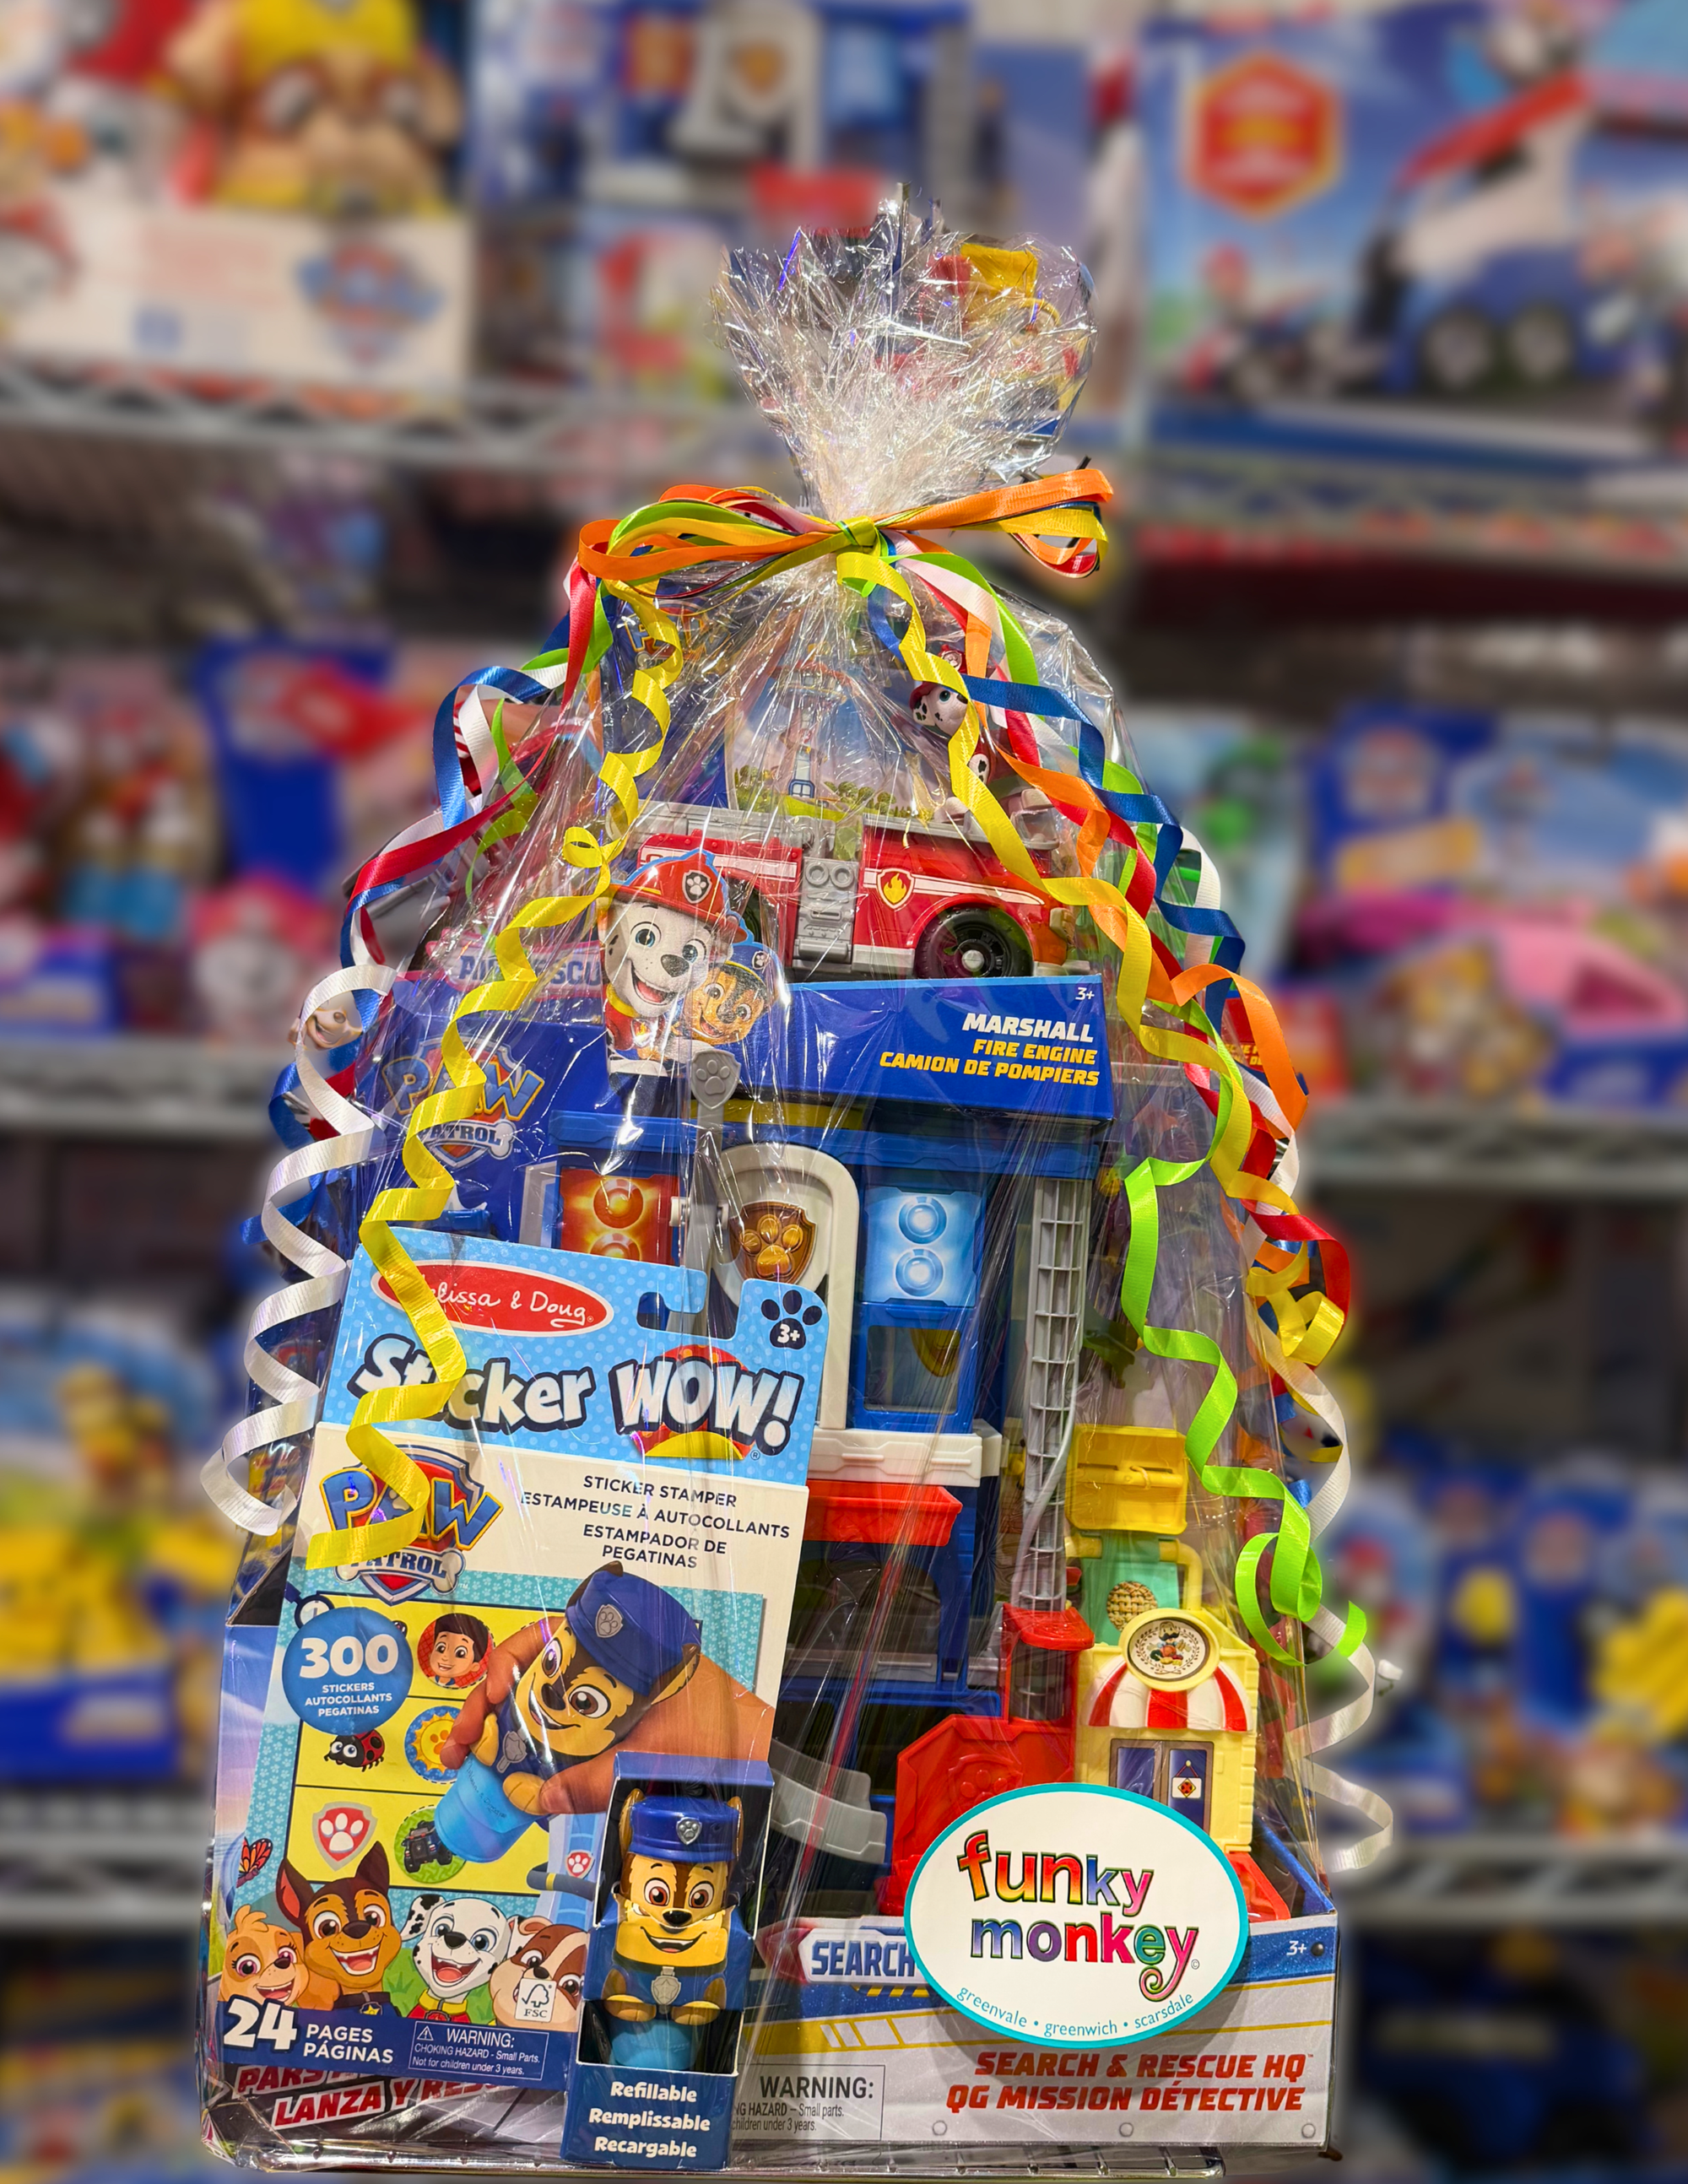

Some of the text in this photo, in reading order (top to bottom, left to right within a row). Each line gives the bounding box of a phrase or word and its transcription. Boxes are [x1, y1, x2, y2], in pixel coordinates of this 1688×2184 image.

[1074, 987, 1095, 1001] 3+
[962, 1013, 1094, 1043] MARSHALL
[972, 1039, 1097, 1065] FIRE ENGINE
[879, 1051, 1100, 1086] CAMION DE POMPIERS
[511, 1290, 522, 1310] &
[530, 1290, 587, 1328] Doug
[777, 1323, 800, 1343] 3+
[350, 1335, 802, 1451] Stcker WOW!
[582, 1475, 738, 1508] STICKER STAMPER
[521, 1491, 790, 1539] ESTAMPEUSE À AUTOCOLLANTS
[582, 1524, 728, 1554] ESTAMPADOR DE
[350, 1551, 446, 1579] ATROL
[602, 1544, 698, 1569] PEGATINAS
[299, 1634, 399, 1679] 300
[305, 1693, 392, 1706] AUTOCOLLANTS
[322, 1682, 375, 1694] STICKERS
[318, 1706, 380, 1717] PEGATINAS
[957, 1829, 1155, 1916] funky
[812, 1940, 915, 1976] SEARCH
[971, 1911, 1199, 2002] monkey
[1286, 1941, 1307, 1956] 3+
[224, 1998, 298, 2051] 24
[524, 2009, 548, 2018] FSC
[957, 1987, 1193, 2037] greenvale greenwich scarsdale
[306, 2024, 374, 2043] PAGES
[446, 2028, 515, 2048] WARNING:
[303, 2041, 394, 2064] PÁGINAS
[414, 2043, 453, 2055] CHOKING
[455, 2047, 489, 2058] HAZARD
[496, 2051, 517, 2061] Small
[518, 2052, 540, 2063] Parts.
[412, 2057, 524, 2075] Not for children under 3 years.
[975, 2052, 1101, 2077] SEARCH
[1106, 2054, 1128, 2078] &
[1137, 2054, 1257, 2079] RESCUE
[610, 2081, 697, 2103] Refillable
[760, 2076, 874, 2099] WARNING:
[947, 2081, 1306, 2113] QG MISSION DÉTECTIVE
[274, 2085, 381, 2127] LANZA
[393, 2079, 415, 2106] Y
[749, 2102, 787, 2116] HAZARD
[798, 2103, 820, 2116] Small
[822, 2106, 844, 2120] parts.
[589, 2108, 711, 2133] Remplissable
[763, 2118, 786, 2131] under
[787, 2120, 793, 2131] 3
[793, 2122, 817, 2133] years.
[594, 2136, 697, 2160] Recargable
